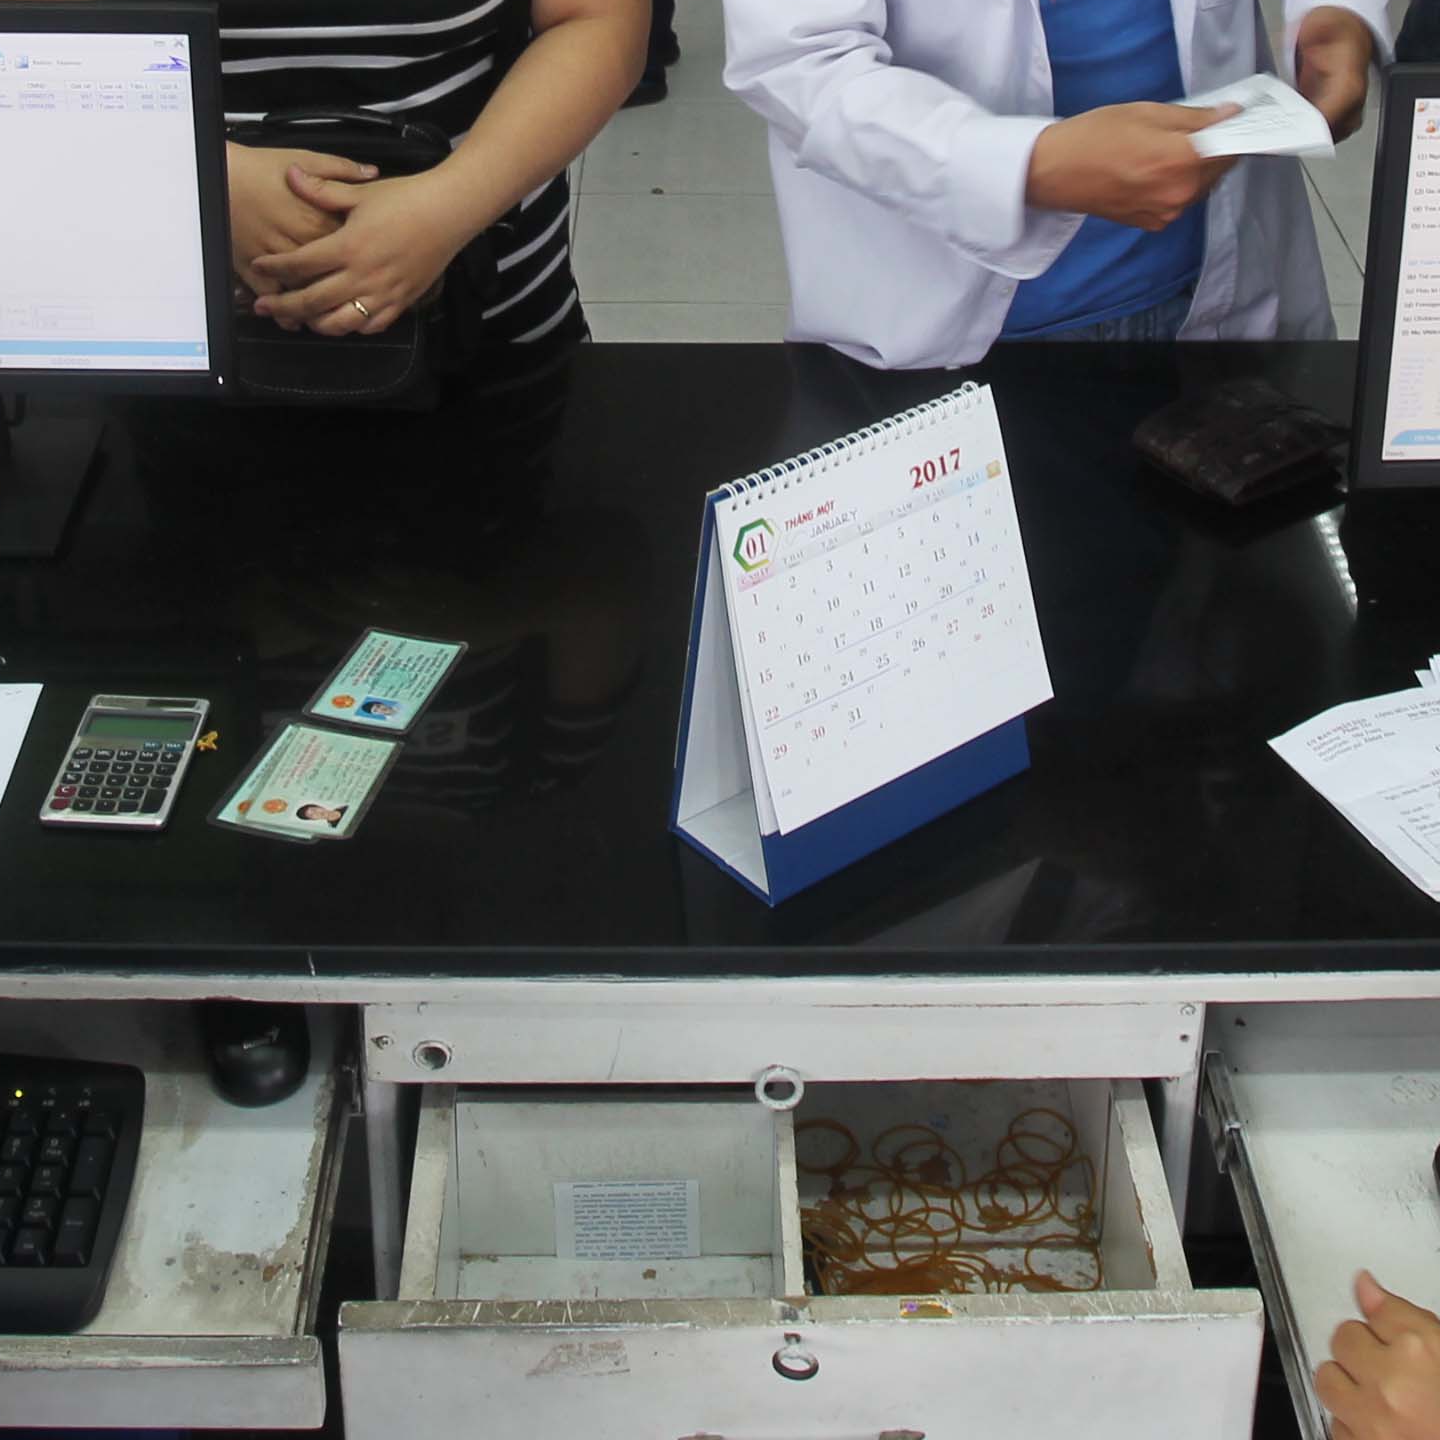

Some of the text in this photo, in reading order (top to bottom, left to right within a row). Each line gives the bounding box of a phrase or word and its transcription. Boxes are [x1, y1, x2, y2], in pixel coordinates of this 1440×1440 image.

[909, 447, 961, 489] 2017
[784, 500, 836, 532] THÁNG MỘT
[809, 509, 858, 539] JANUARY
[746, 532, 766, 560] 01
[752, 494, 973, 606] 1 2 3 4 5 6 7
[758, 530, 981, 643] 8 9 10 11 12 13 14
[759, 567, 987, 685] 15 16 17 18 19 20 21
[764, 602, 995, 722] 22 23 24 25 26 27 28
[772, 706, 862, 760] 29 30 31
